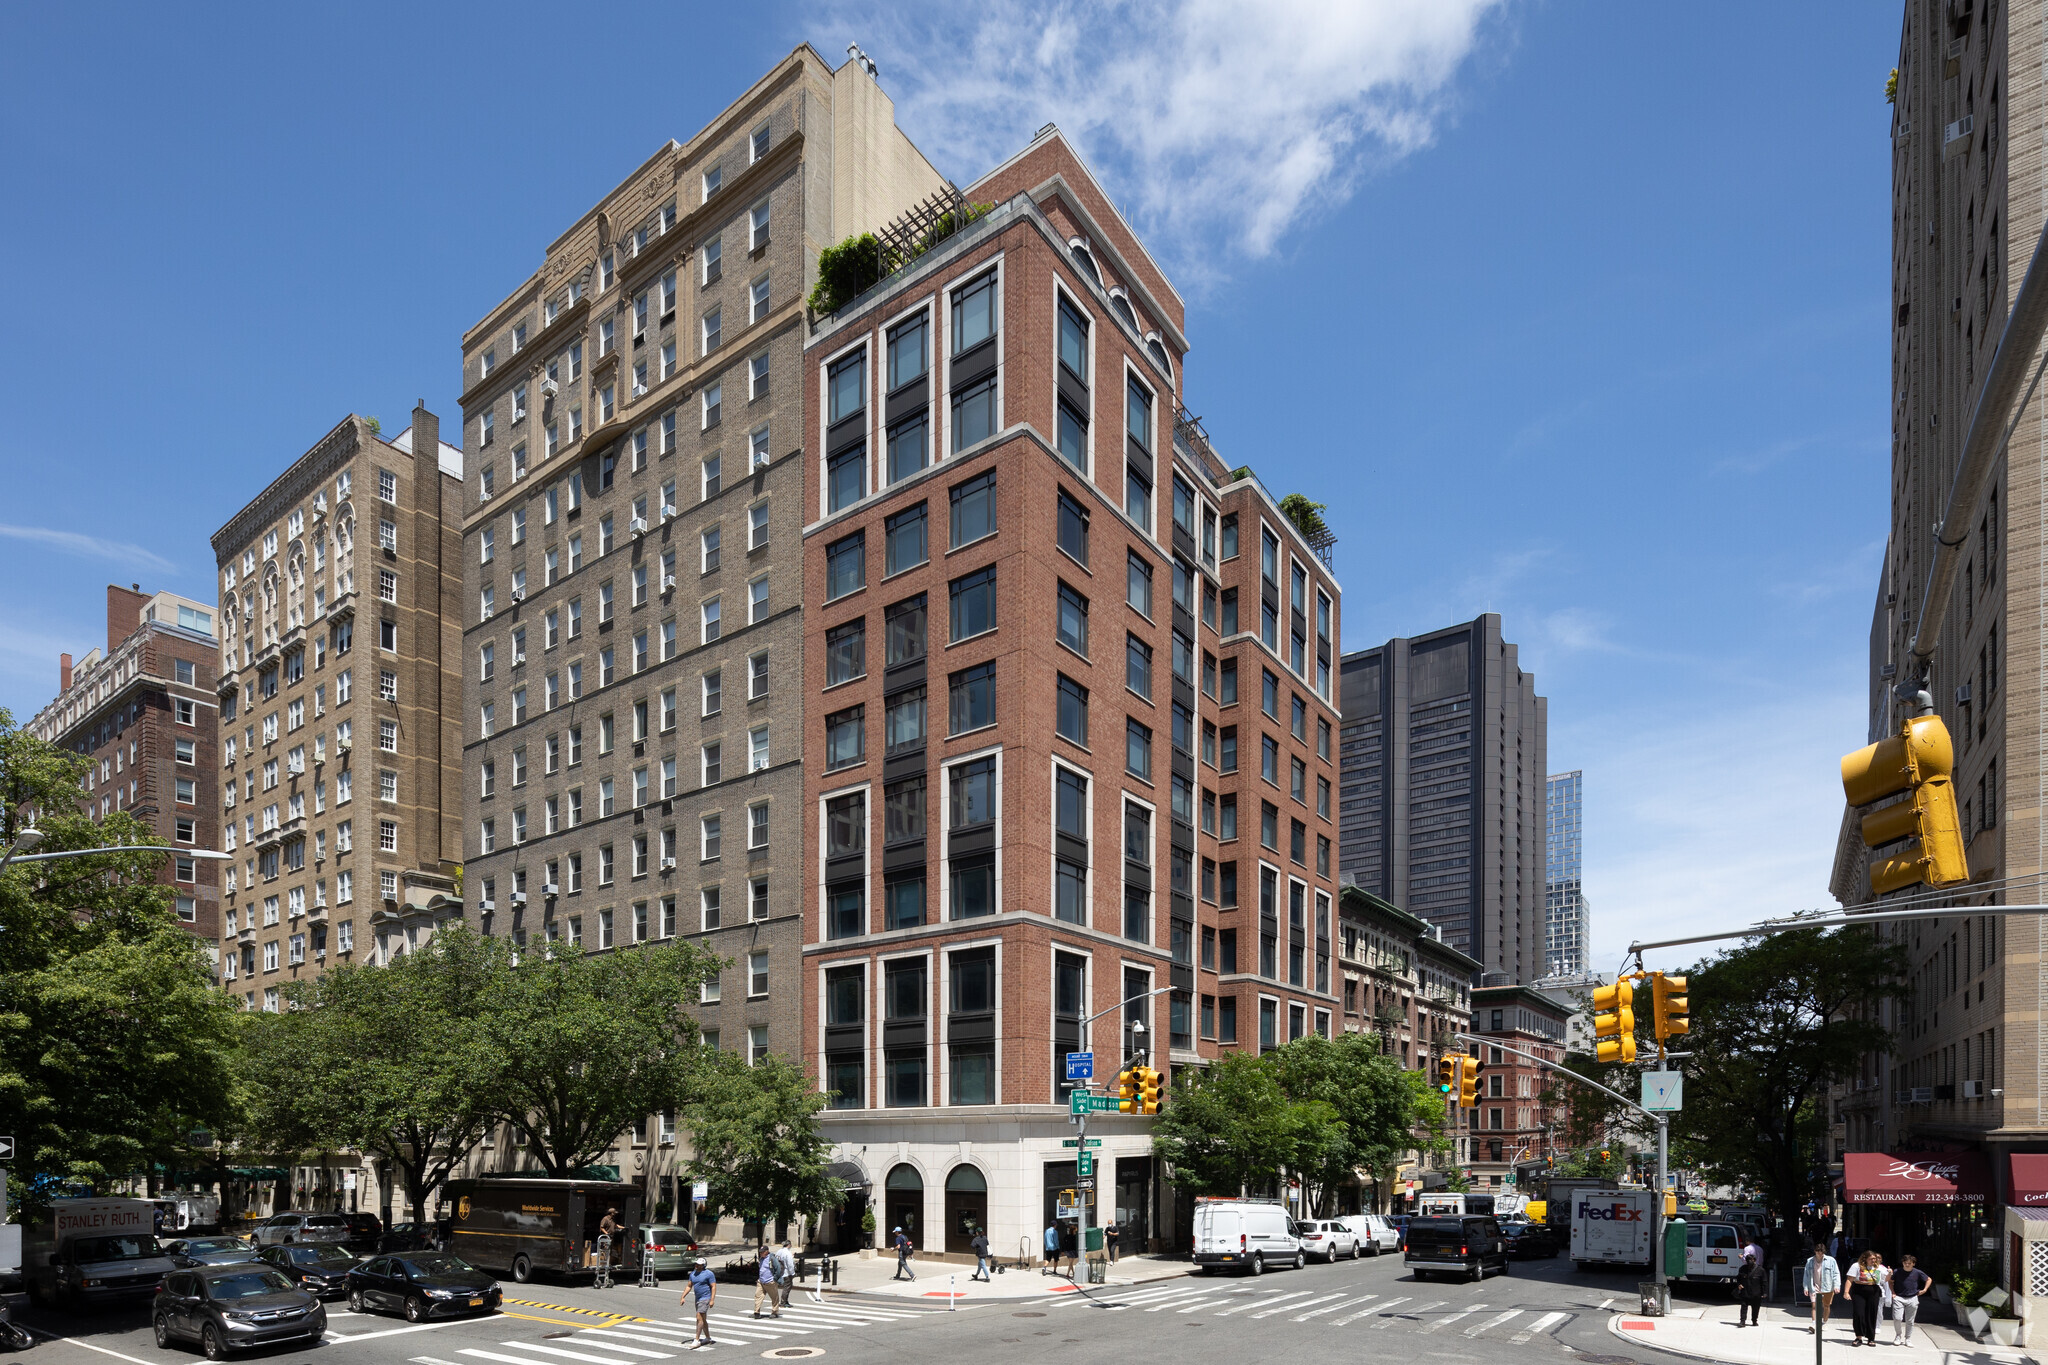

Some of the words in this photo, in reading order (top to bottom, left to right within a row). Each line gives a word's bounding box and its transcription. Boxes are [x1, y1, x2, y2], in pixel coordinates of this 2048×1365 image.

[1092, 1099, 1119, 1108] Madson
[1854, 1193, 1915, 1201] RESTAURANT
[1925, 1193, 1984, 1201] 212-348-3800
[1578, 1202, 1643, 1221] FedEx
[59, 1215, 107, 1229] STANLEY
[111, 1213, 140, 1226] RUTH
